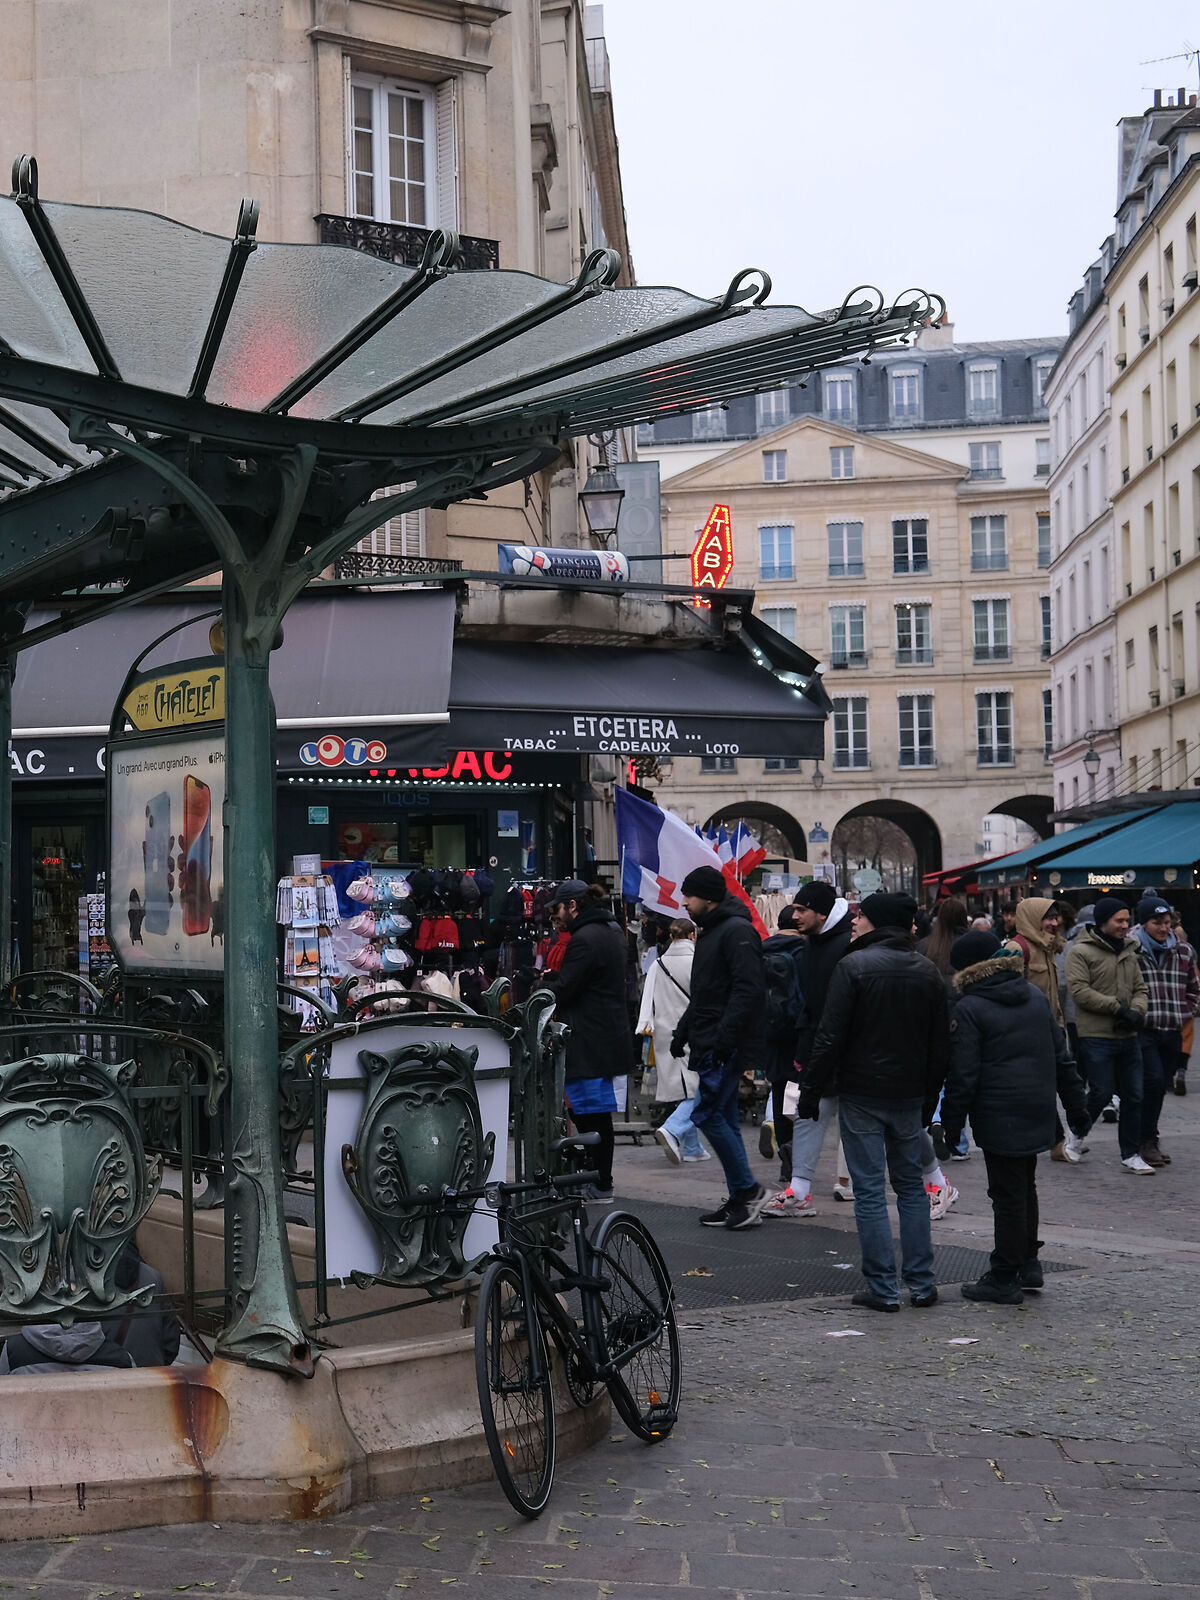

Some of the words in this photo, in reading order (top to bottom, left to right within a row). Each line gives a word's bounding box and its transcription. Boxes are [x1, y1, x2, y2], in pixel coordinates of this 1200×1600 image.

[551, 557, 600, 567] FRANÇAISE
[699, 519, 725, 603] TABA
[556, 568, 572, 577] DES
[576, 569, 598, 579] JEUX
[573, 716, 679, 740] ETCETERA
[301, 736, 385, 765] LOTO
[504, 738, 557, 750] TABAC
[598, 740, 671, 752] CADEAUX
[706, 743, 740, 754] LOTO
[116, 763, 126, 775] Un
[143, 760, 158, 772] Avec
[158, 761, 166, 770] un
[166, 756, 183, 772] grand
